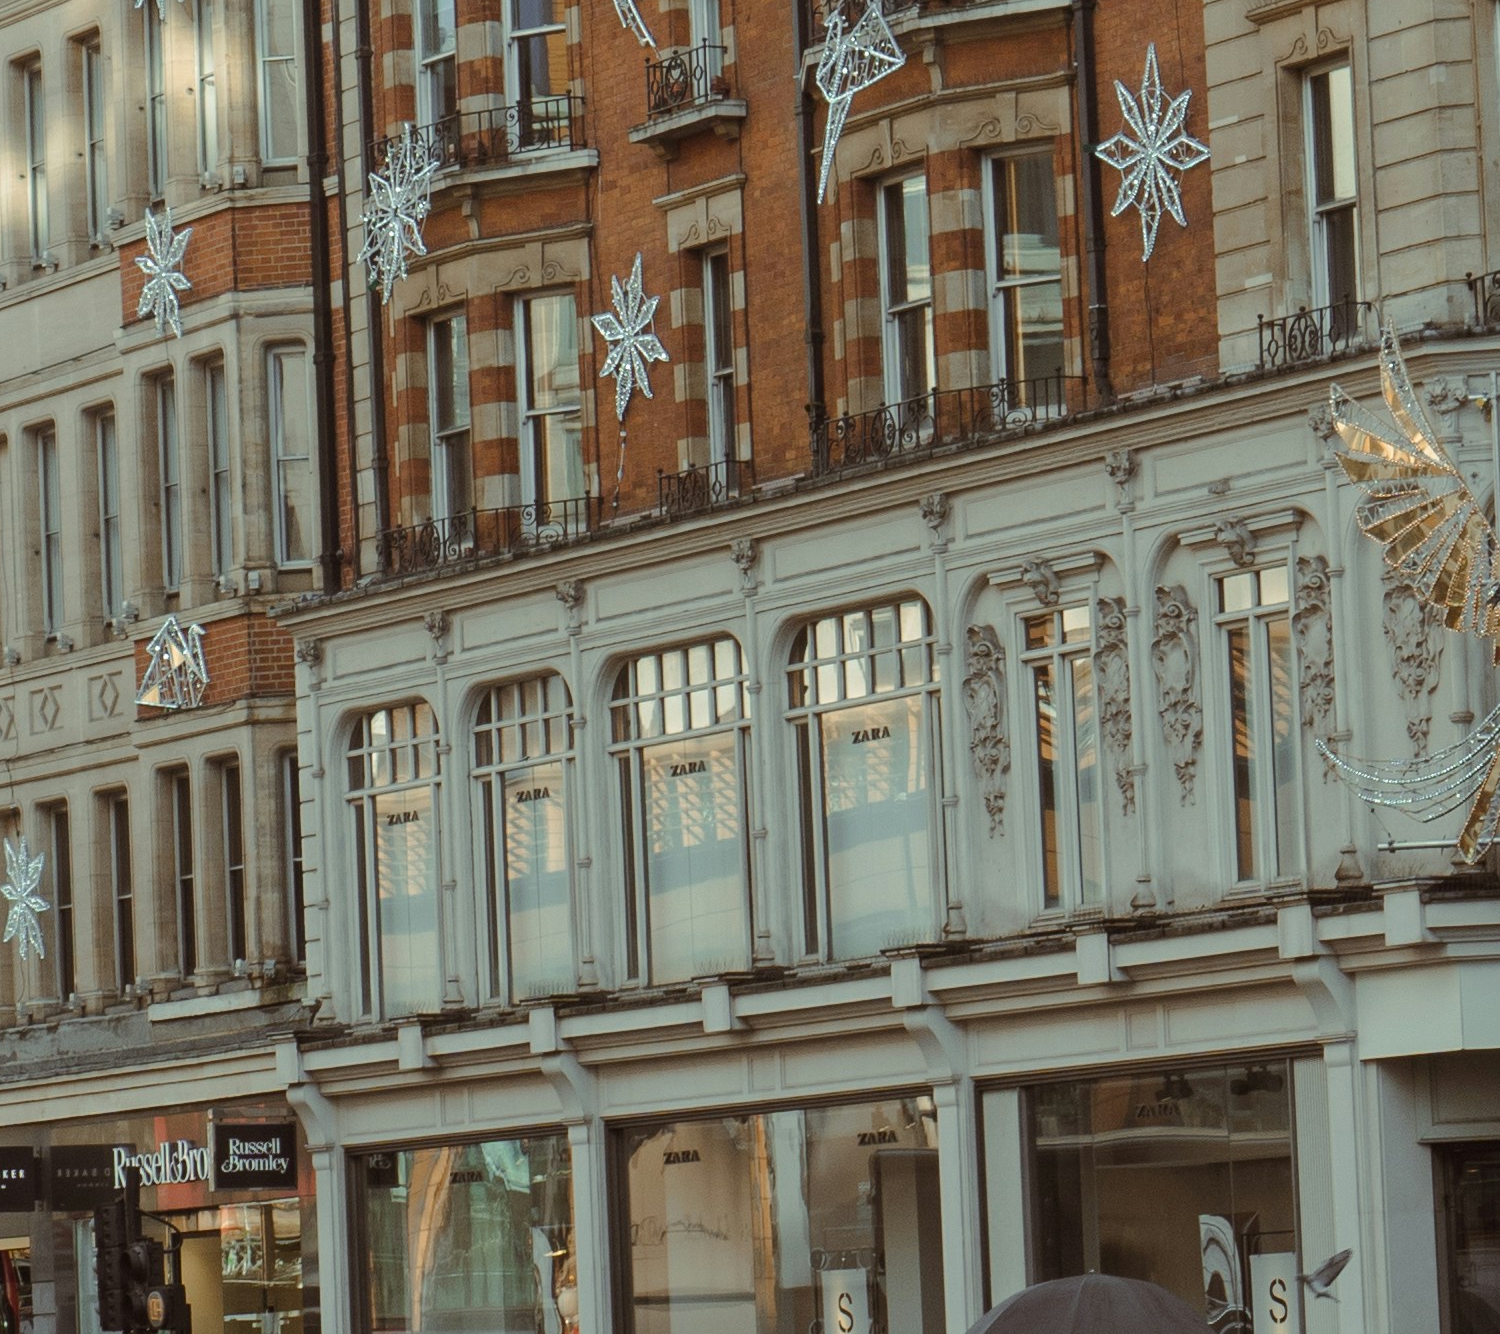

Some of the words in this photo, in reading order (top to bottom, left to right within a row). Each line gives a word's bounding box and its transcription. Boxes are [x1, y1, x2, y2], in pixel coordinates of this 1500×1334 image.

[857, 1130, 899, 1146] ZARA
[229, 1138, 281, 1155] Russell
[662, 1151, 700, 1166] ZARA
[451, 1171, 484, 1184] ZARA
